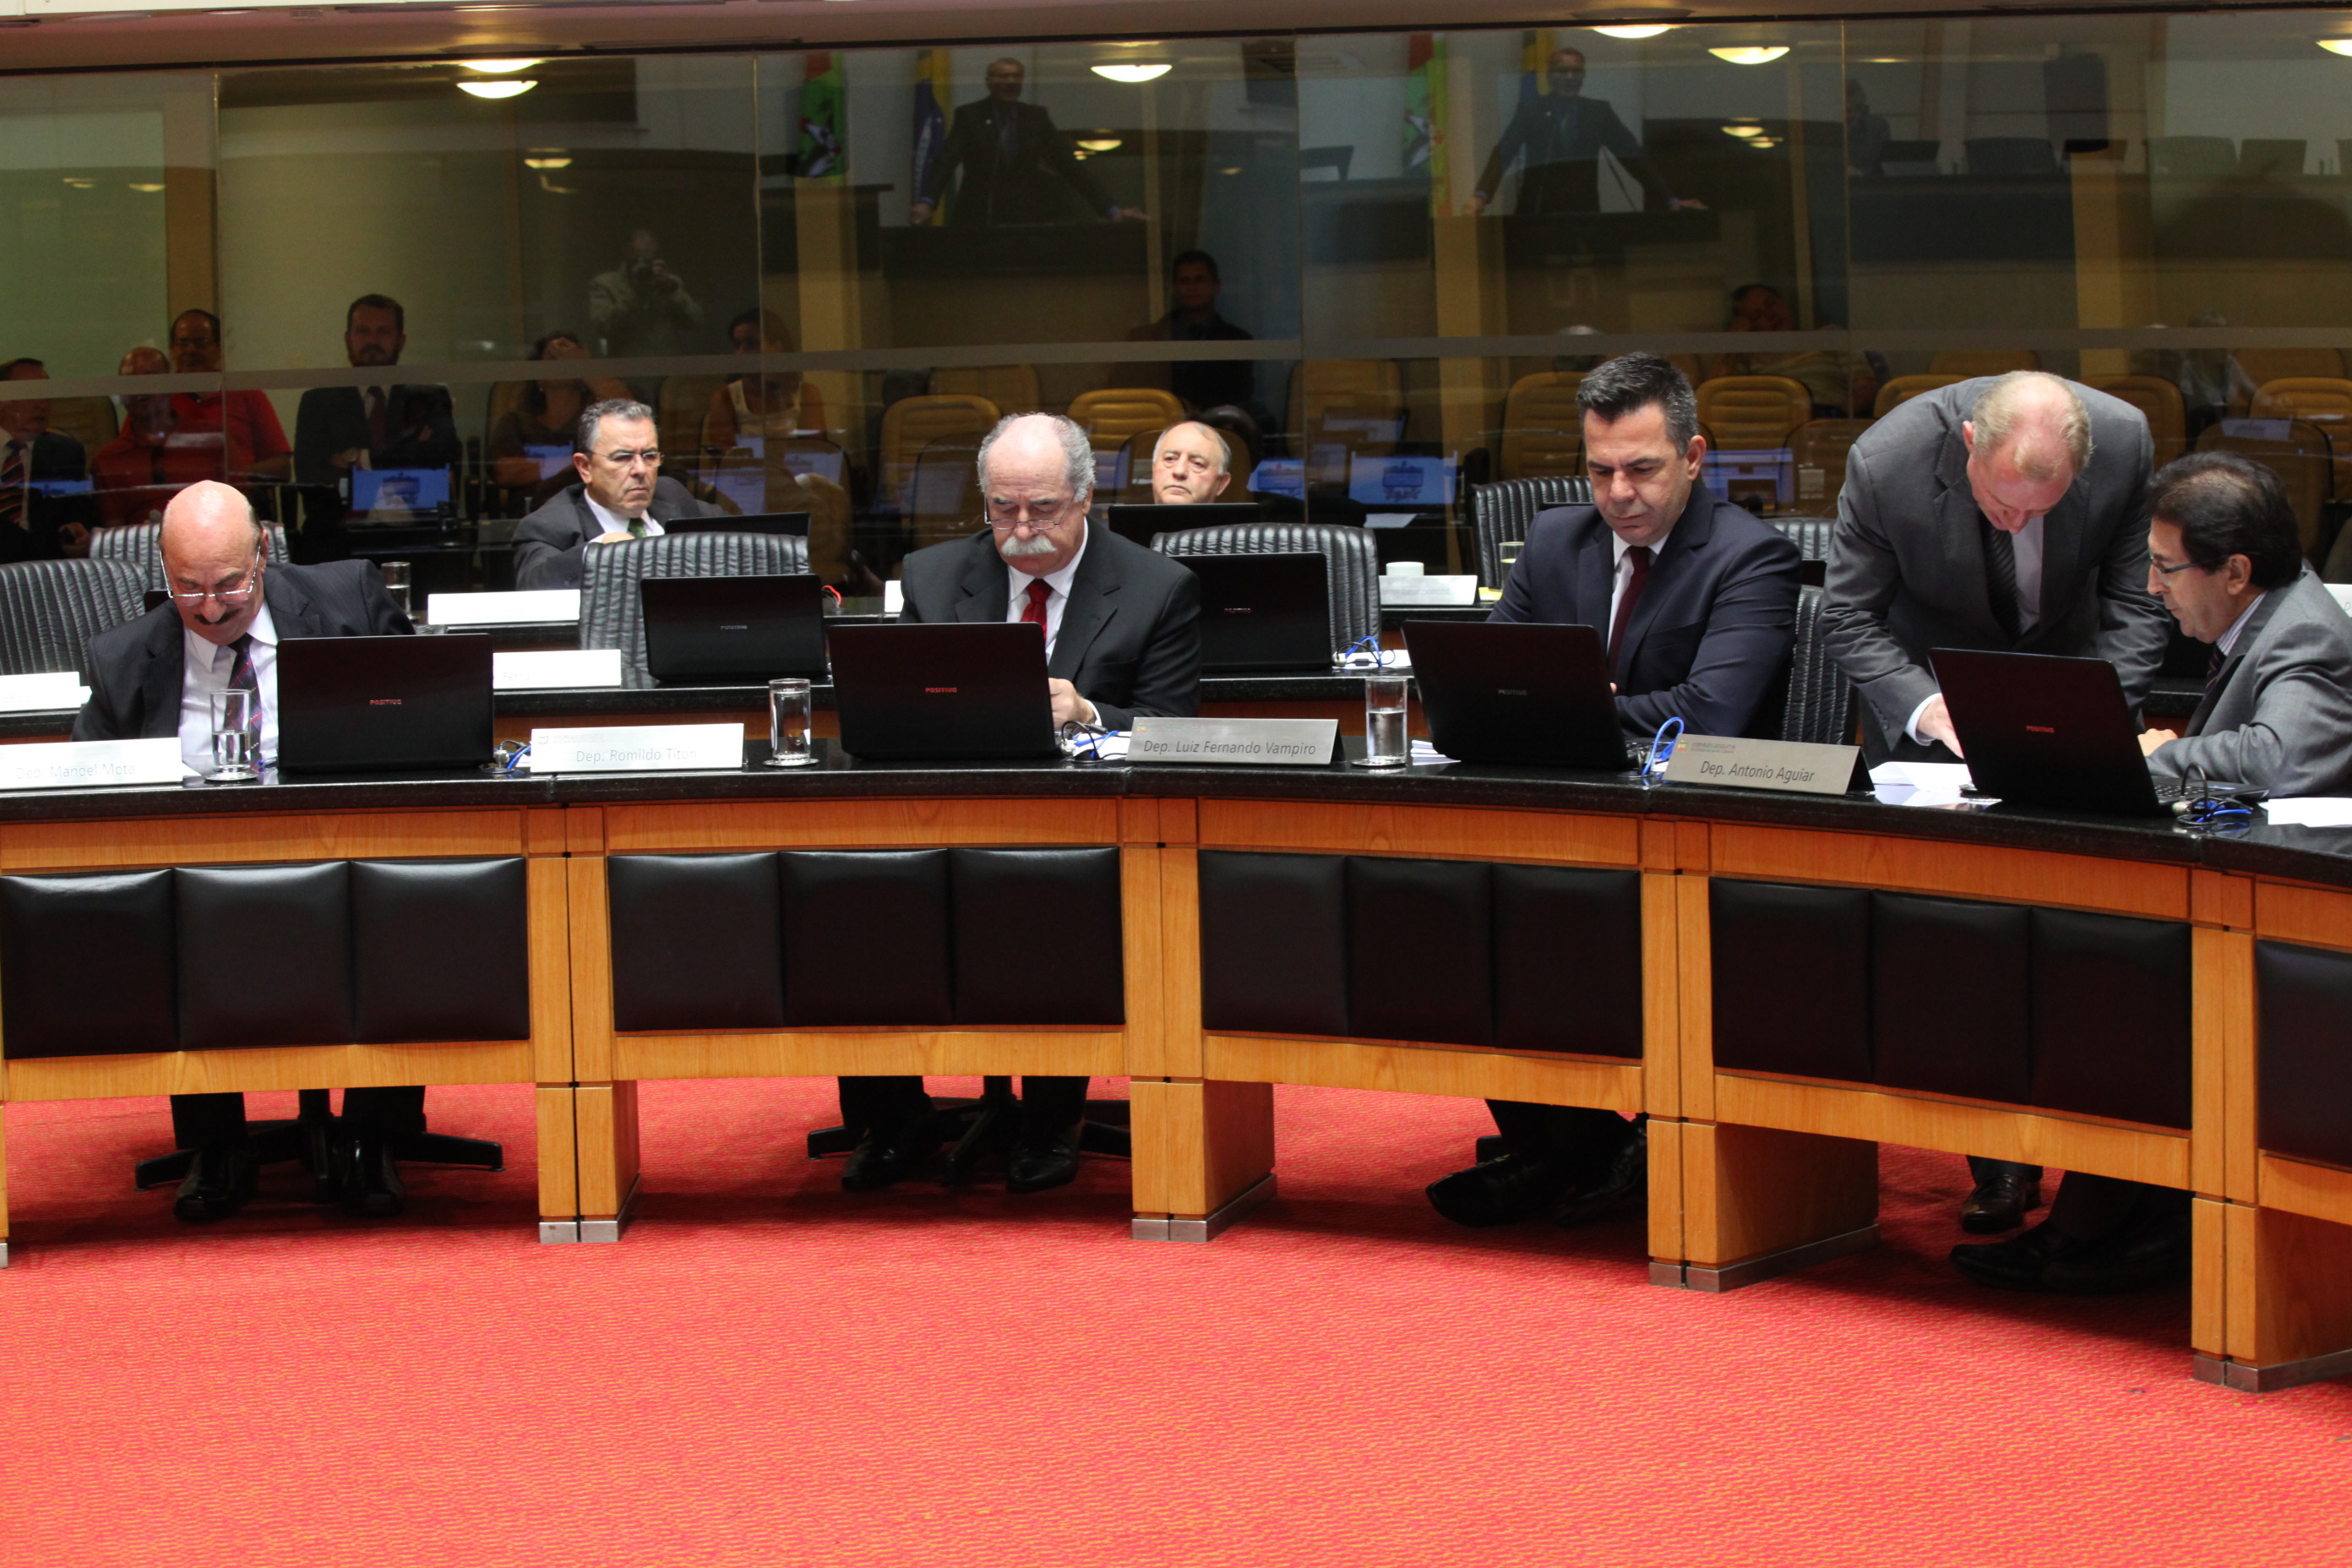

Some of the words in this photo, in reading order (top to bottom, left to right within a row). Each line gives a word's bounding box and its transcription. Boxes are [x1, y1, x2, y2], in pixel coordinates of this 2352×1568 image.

[576, 749, 605, 765] Dep.
[609, 748, 662, 762] Romildo
[666, 747, 697, 760] Titon
[1144, 740, 1171, 754] Dep.
[1175, 741, 1200, 753] Luiz
[1203, 741, 1261, 754] Fernando
[1266, 742, 1316, 757] Vampiro
[50, 764, 97, 777] Manoel
[102, 763, 135, 776] Mota
[1700, 760, 1725, 776] Dep.
[1729, 763, 1774, 780] Antonio
[1775, 766, 1816, 784] Aguiar
